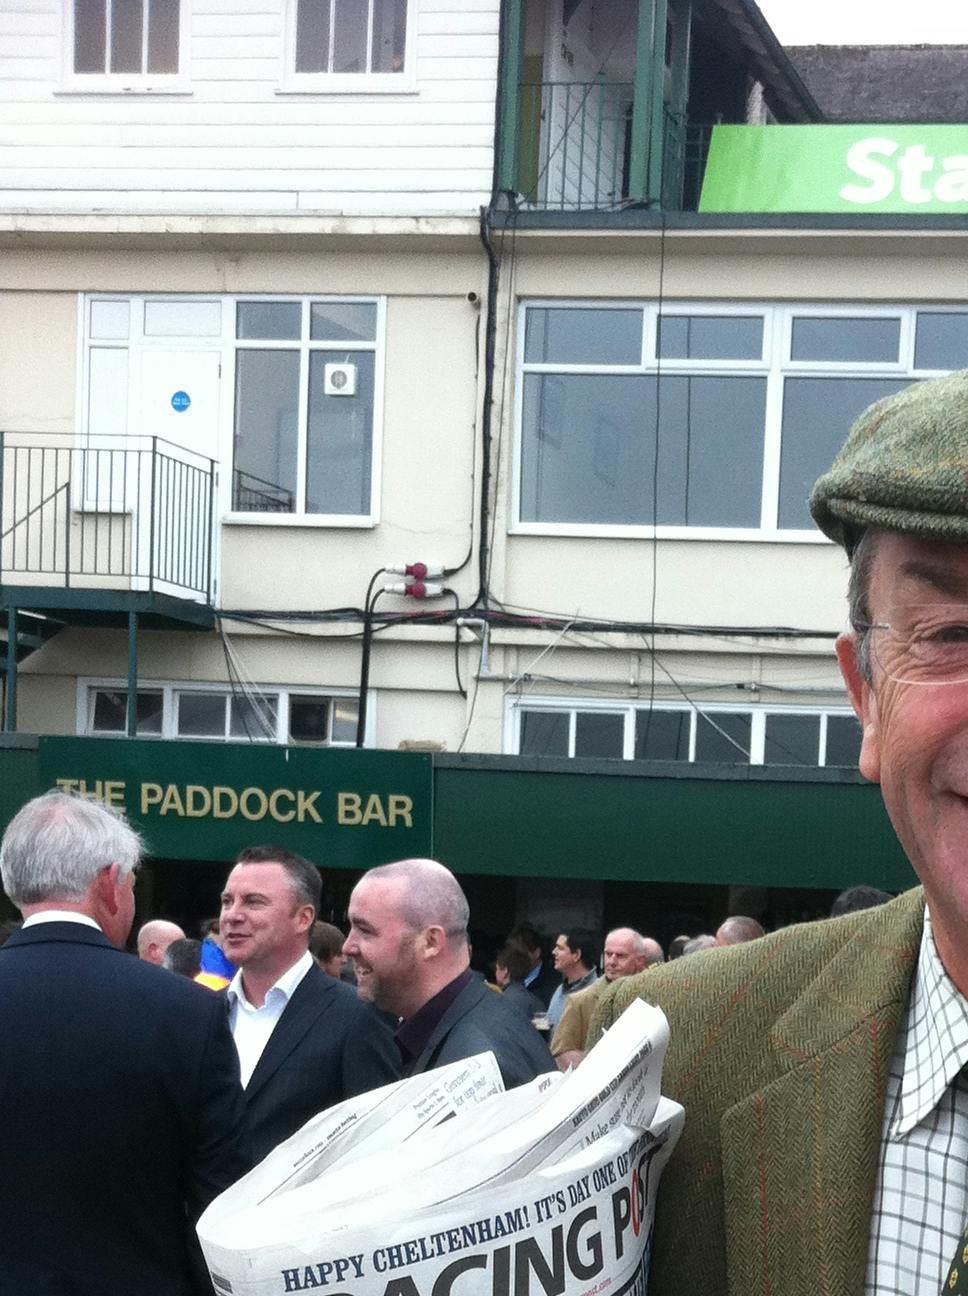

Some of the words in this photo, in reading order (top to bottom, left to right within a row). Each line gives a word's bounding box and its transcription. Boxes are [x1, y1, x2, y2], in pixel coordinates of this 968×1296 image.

[140, 783, 324, 824] PADDOCK
[337, 793, 414, 827] BAR
[281, 1255, 365, 1293] HAPPY
[372, 1205, 531, 1279] CHELTENHAM!
[534, 1190, 567, 1224] IT'S
[567, 1175, 592, 1208] DAY
[592, 1161, 617, 1192] ONE
[617, 1151, 629, 1178] OF
